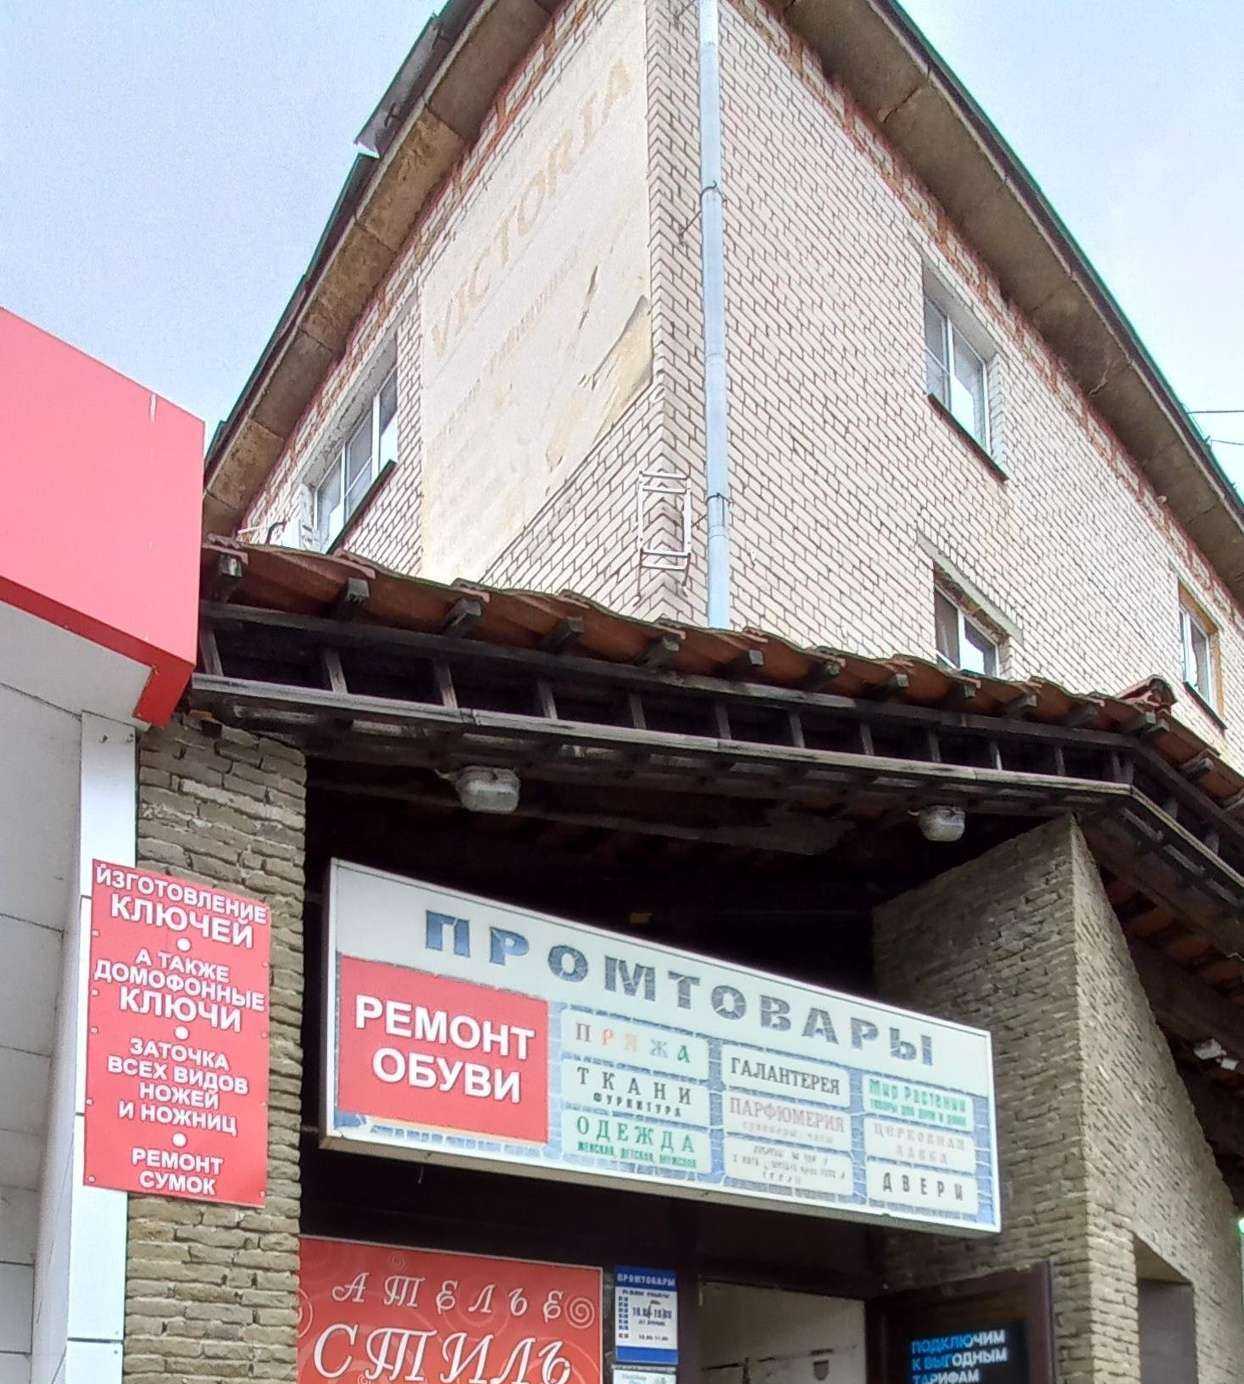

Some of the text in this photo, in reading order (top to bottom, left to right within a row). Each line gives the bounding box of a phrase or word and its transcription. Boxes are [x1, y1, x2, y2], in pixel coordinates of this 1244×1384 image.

[95, 865, 267, 925] ИЗГОТОВЛЕНИЕ
[111, 893, 253, 948] КЛЮЧЕЙ
[135, 949, 230, 983] А ТАКЖЕ
[94, 959, 265, 1012] ДОМОФОННЫЕ
[425, 909, 933, 1067] ПРОМТОВАРЫ
[120, 986, 241, 1032] КЛЮЧИ
[355, 994, 535, 1060] РЕМОНТ
[129, 1038, 229, 1071] ЗАТОЧКА
[576, 1022, 691, 1064] ПРЯЖА
[108, 1056, 249, 1095] ВСЕХ ВИДОВ
[372, 1047, 521, 1104] ОБУВИ
[577, 1067, 692, 1105] ТКАНИ
[731, 1057, 840, 1095] ГАЛАНТЕРЕЯ
[139, 1081, 219, 1109] НОЖЕЙ
[119, 1102, 237, 1136] И НОЖНИЦ
[730, 1097, 844, 1133] ПАРФЮМЕРИЯ
[577, 1116, 694, 1153] ОДЕЖДА
[132, 1148, 223, 1176] РЕМОНТ
[139, 1171, 216, 1195] СУМОК
[883, 1172, 963, 1201] ДВЕРИ
[332, 1272, 564, 1323] АТЕЛЬЕ
[912, 1329, 1006, 1354] ПОДКЛЮЧИМ
[924, 1347, 1008, 1370] ВЫГОДНЫМ
